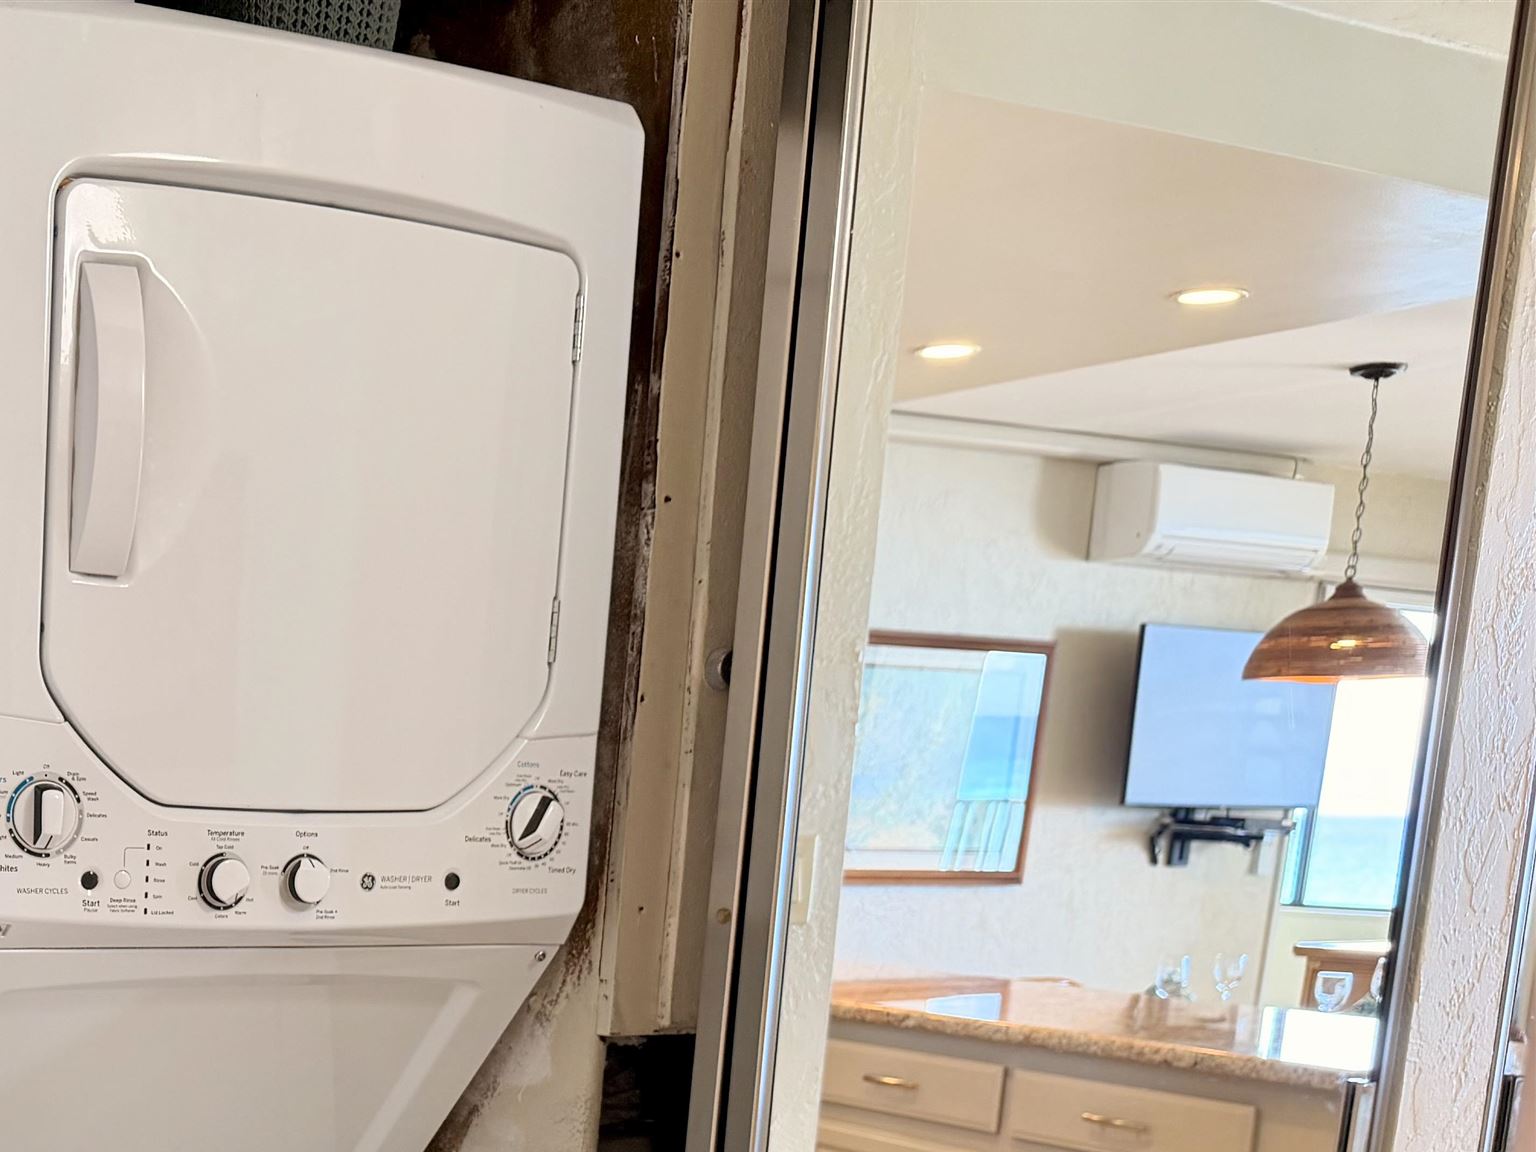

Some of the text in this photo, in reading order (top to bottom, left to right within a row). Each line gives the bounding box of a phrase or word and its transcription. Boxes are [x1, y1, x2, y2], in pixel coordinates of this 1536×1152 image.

[559, 769, 573, 778] Easy
[147, 829, 169, 838] Status
[207, 829, 245, 837] Temperature
[464, 835, 492, 843] Delicates
[565, 866, 577, 875] Dry
[16, 887, 69, 895] WASHER CYCLES
[81, 900, 100, 908] Start
[445, 899, 460, 907] Start
